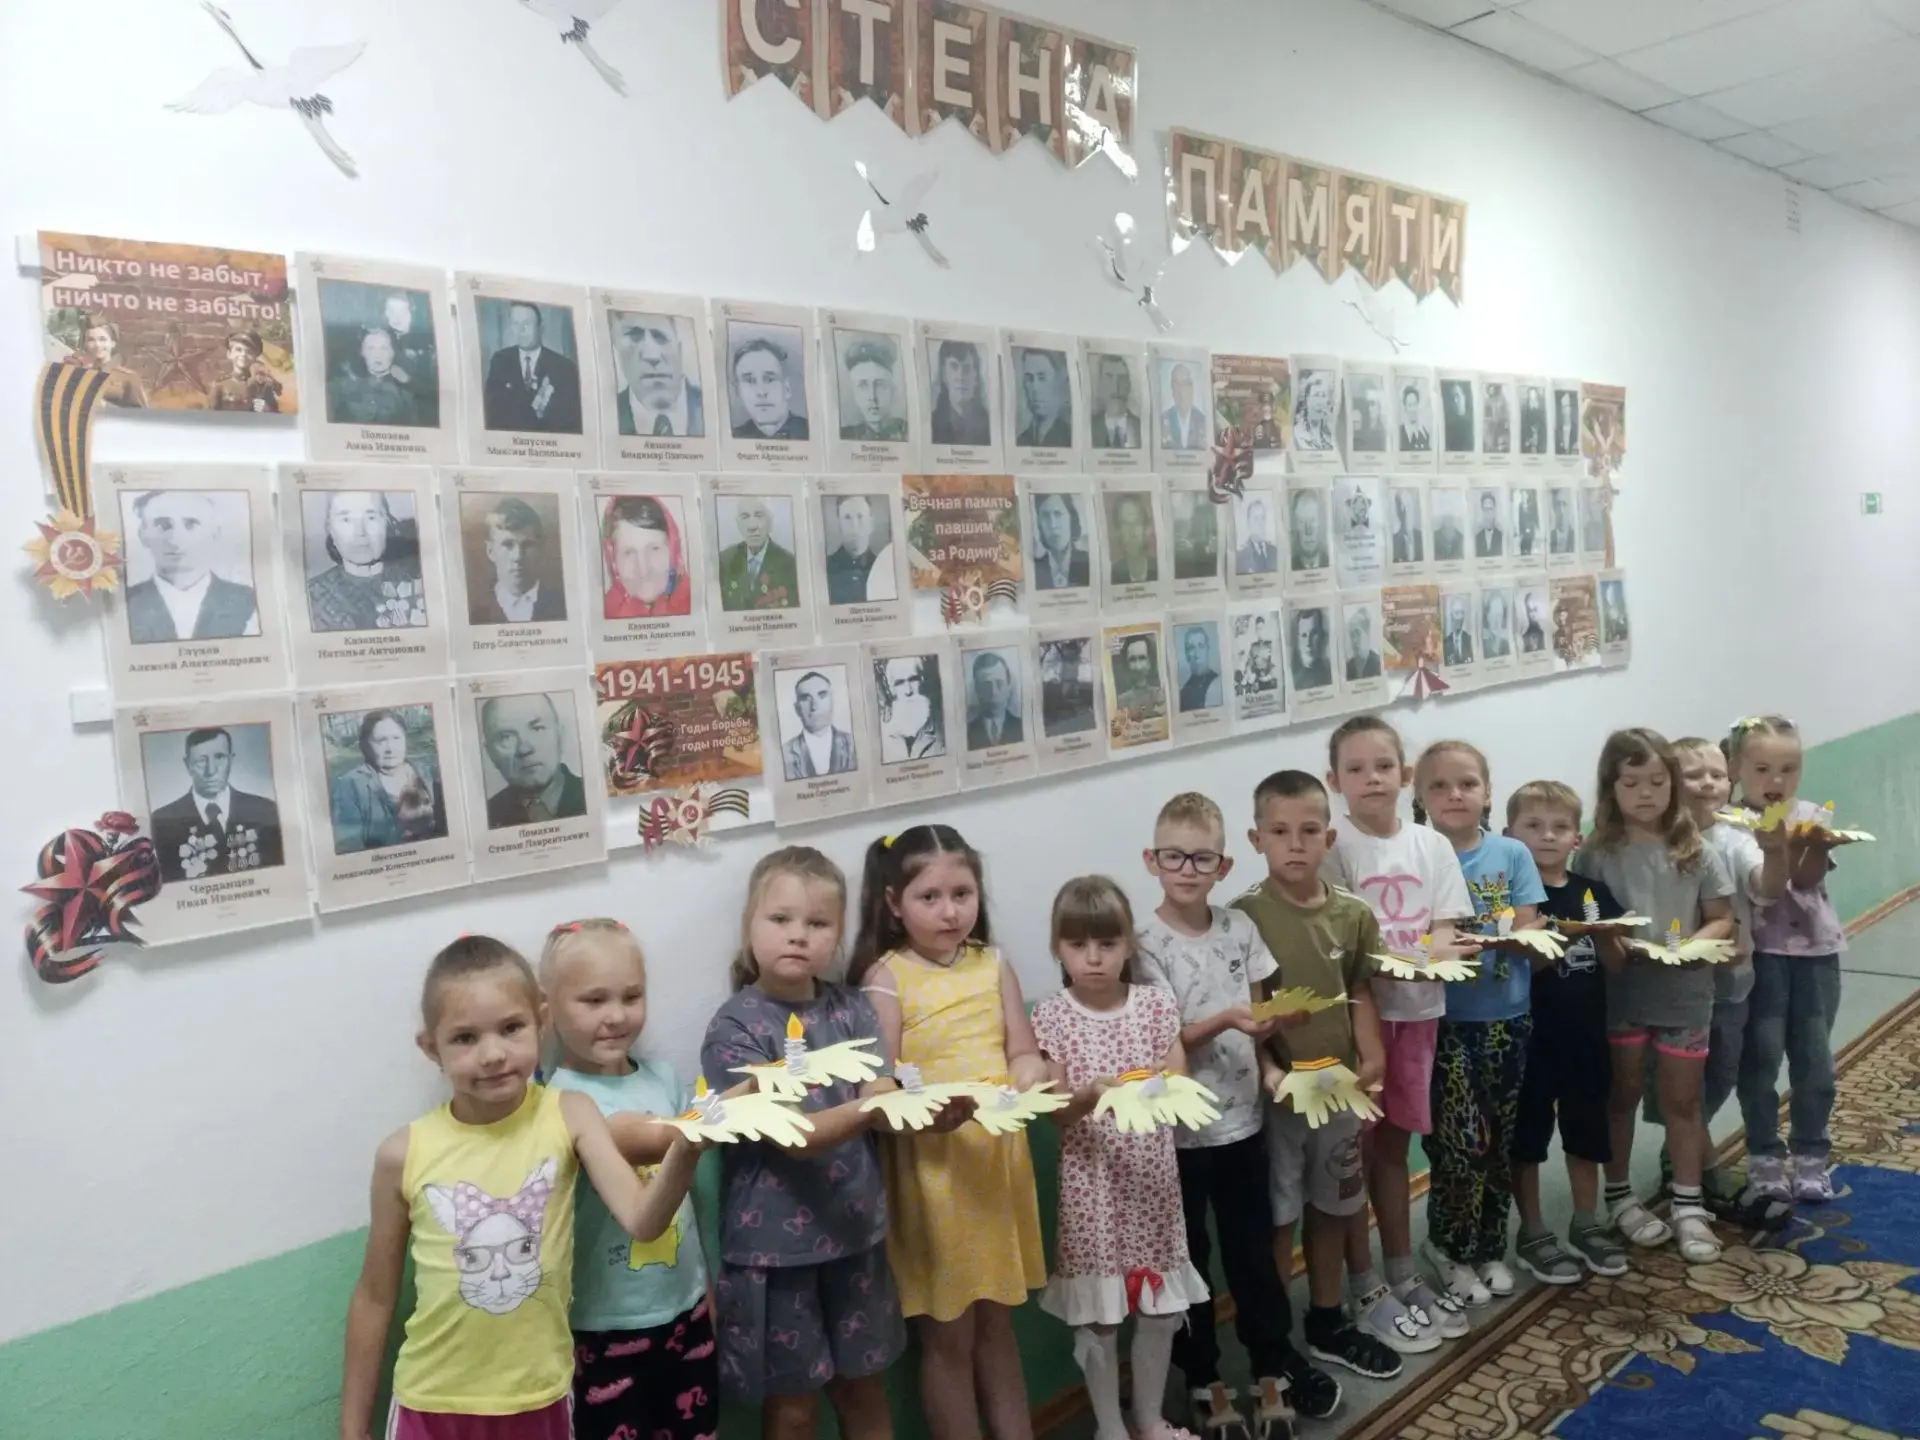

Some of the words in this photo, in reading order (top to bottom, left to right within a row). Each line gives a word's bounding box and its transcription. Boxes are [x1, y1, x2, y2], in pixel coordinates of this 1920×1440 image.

[739, 0, 1121, 143] СТЕНА
[1182, 153, 1458, 273] ПАМЯТИ
[56, 250, 142, 277] Никто
[149, 264, 180, 279] не
[187, 264, 269, 290] забыт,
[55, 288, 139, 310] ничто
[146, 296, 178, 312] не
[185, 298, 281, 320] забыто!
[909, 495, 962, 510] Вечная
[964, 496, 1012, 510] память
[935, 522, 994, 535] павшим
[930, 549, 945, 561] за
[949, 545, 1004, 562] Родину!
[602, 659, 745, 697] 1941-1945
[680, 723, 710, 735] Годы
[682, 740, 710, 752] годы
[176, 898, 208, 910] Иван
